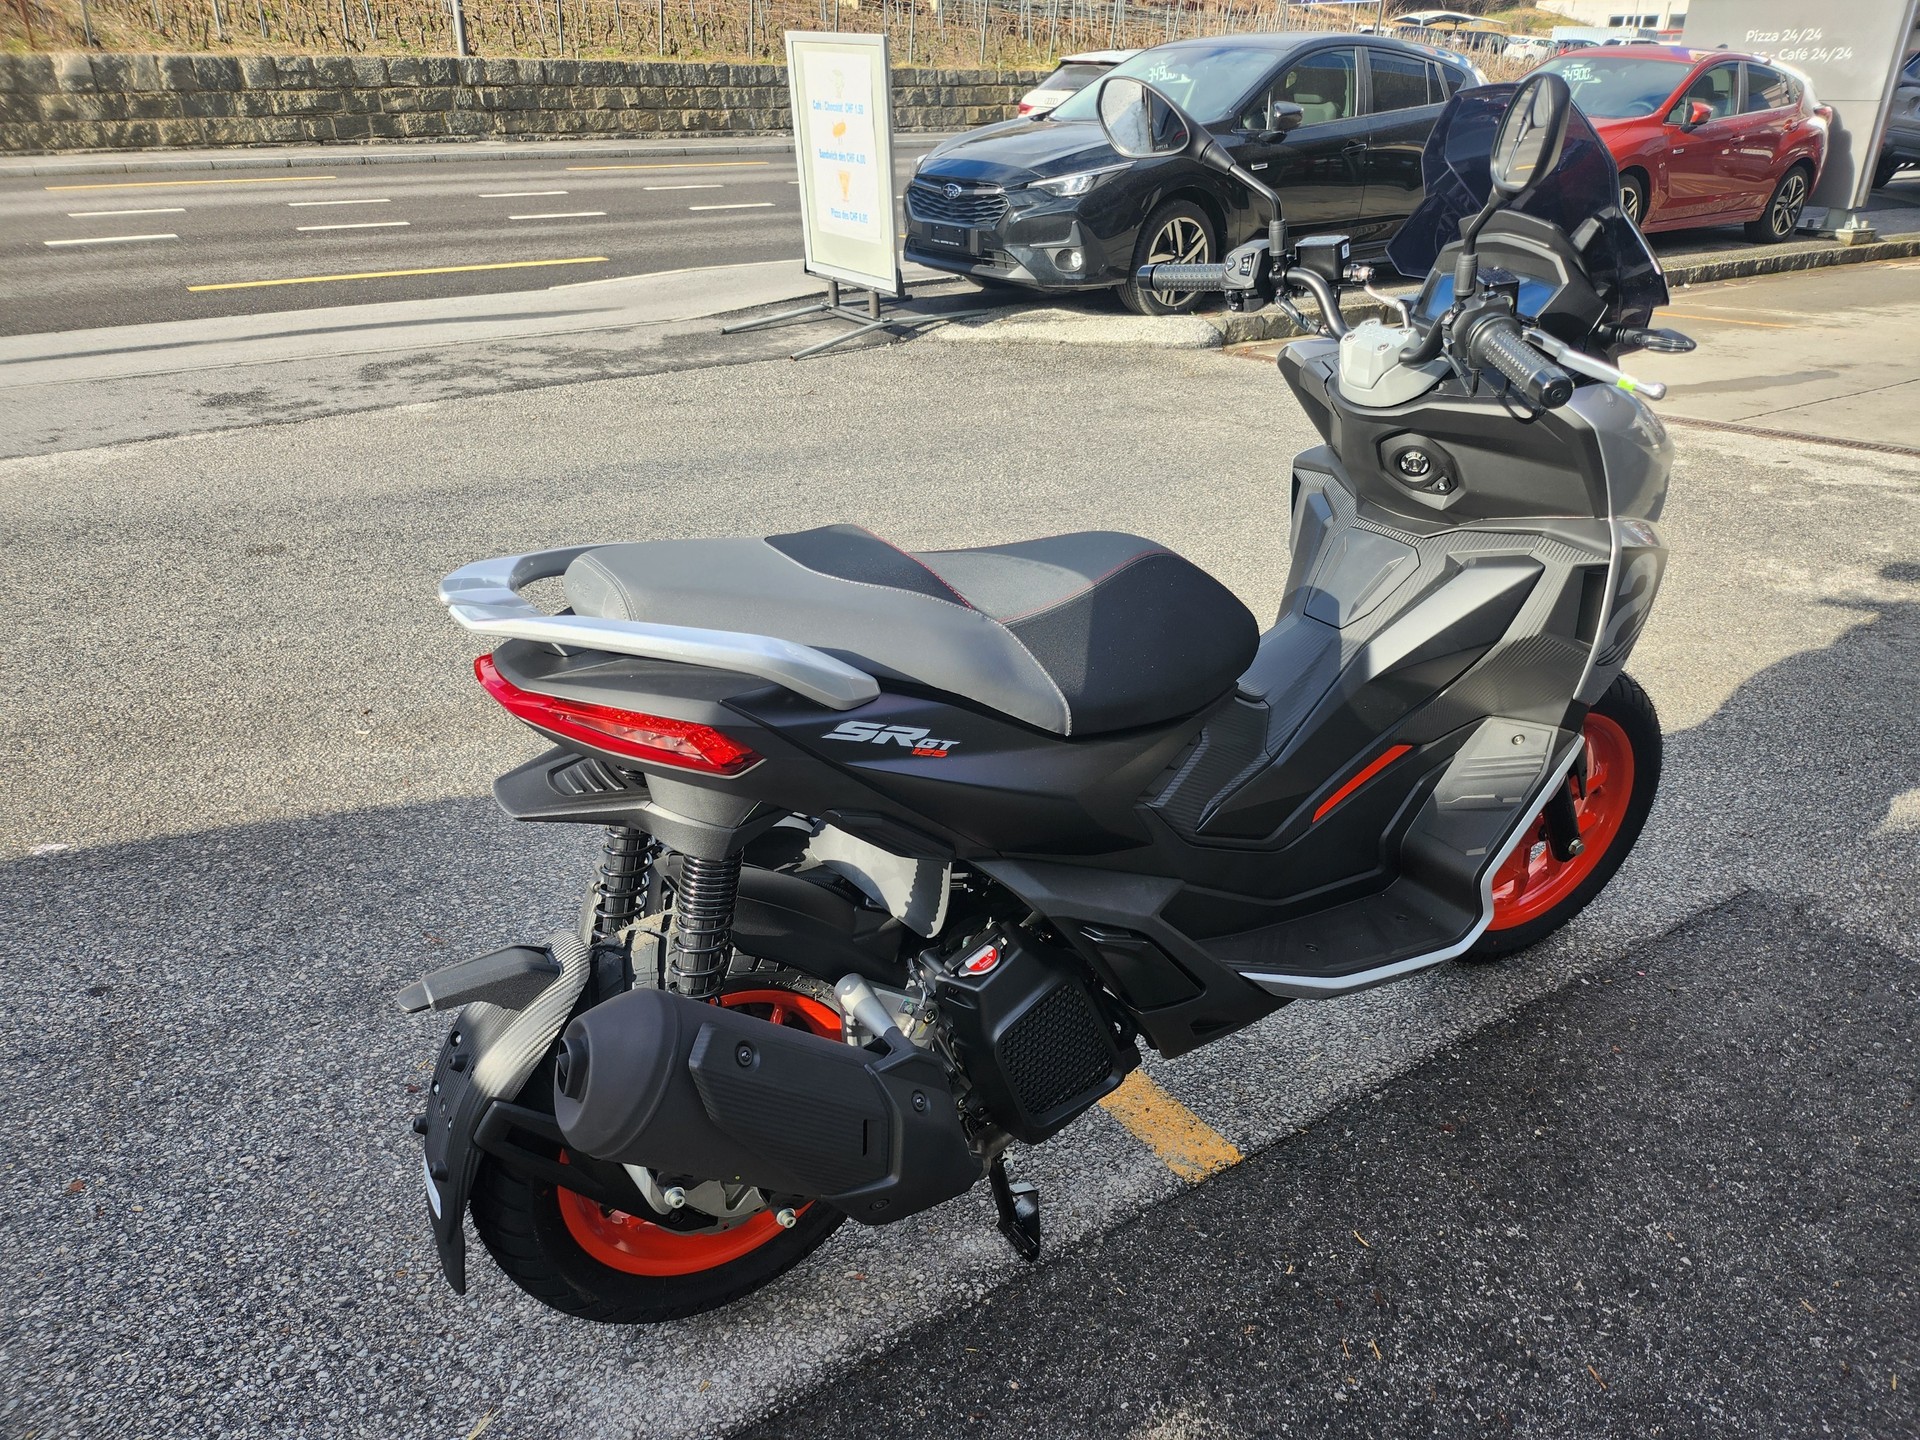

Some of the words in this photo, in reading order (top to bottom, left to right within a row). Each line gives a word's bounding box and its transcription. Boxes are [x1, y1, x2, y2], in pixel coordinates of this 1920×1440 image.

[1745, 29, 1780, 42] Pizza
[1781, 27, 1823, 45] 24/24
[1778, 47, 1808, 60] Café
[1810, 46, 1853, 64] 24/24
[821, 720, 931, 748] SR
[914, 738, 960, 750] GT
[911, 747, 949, 758] 125
